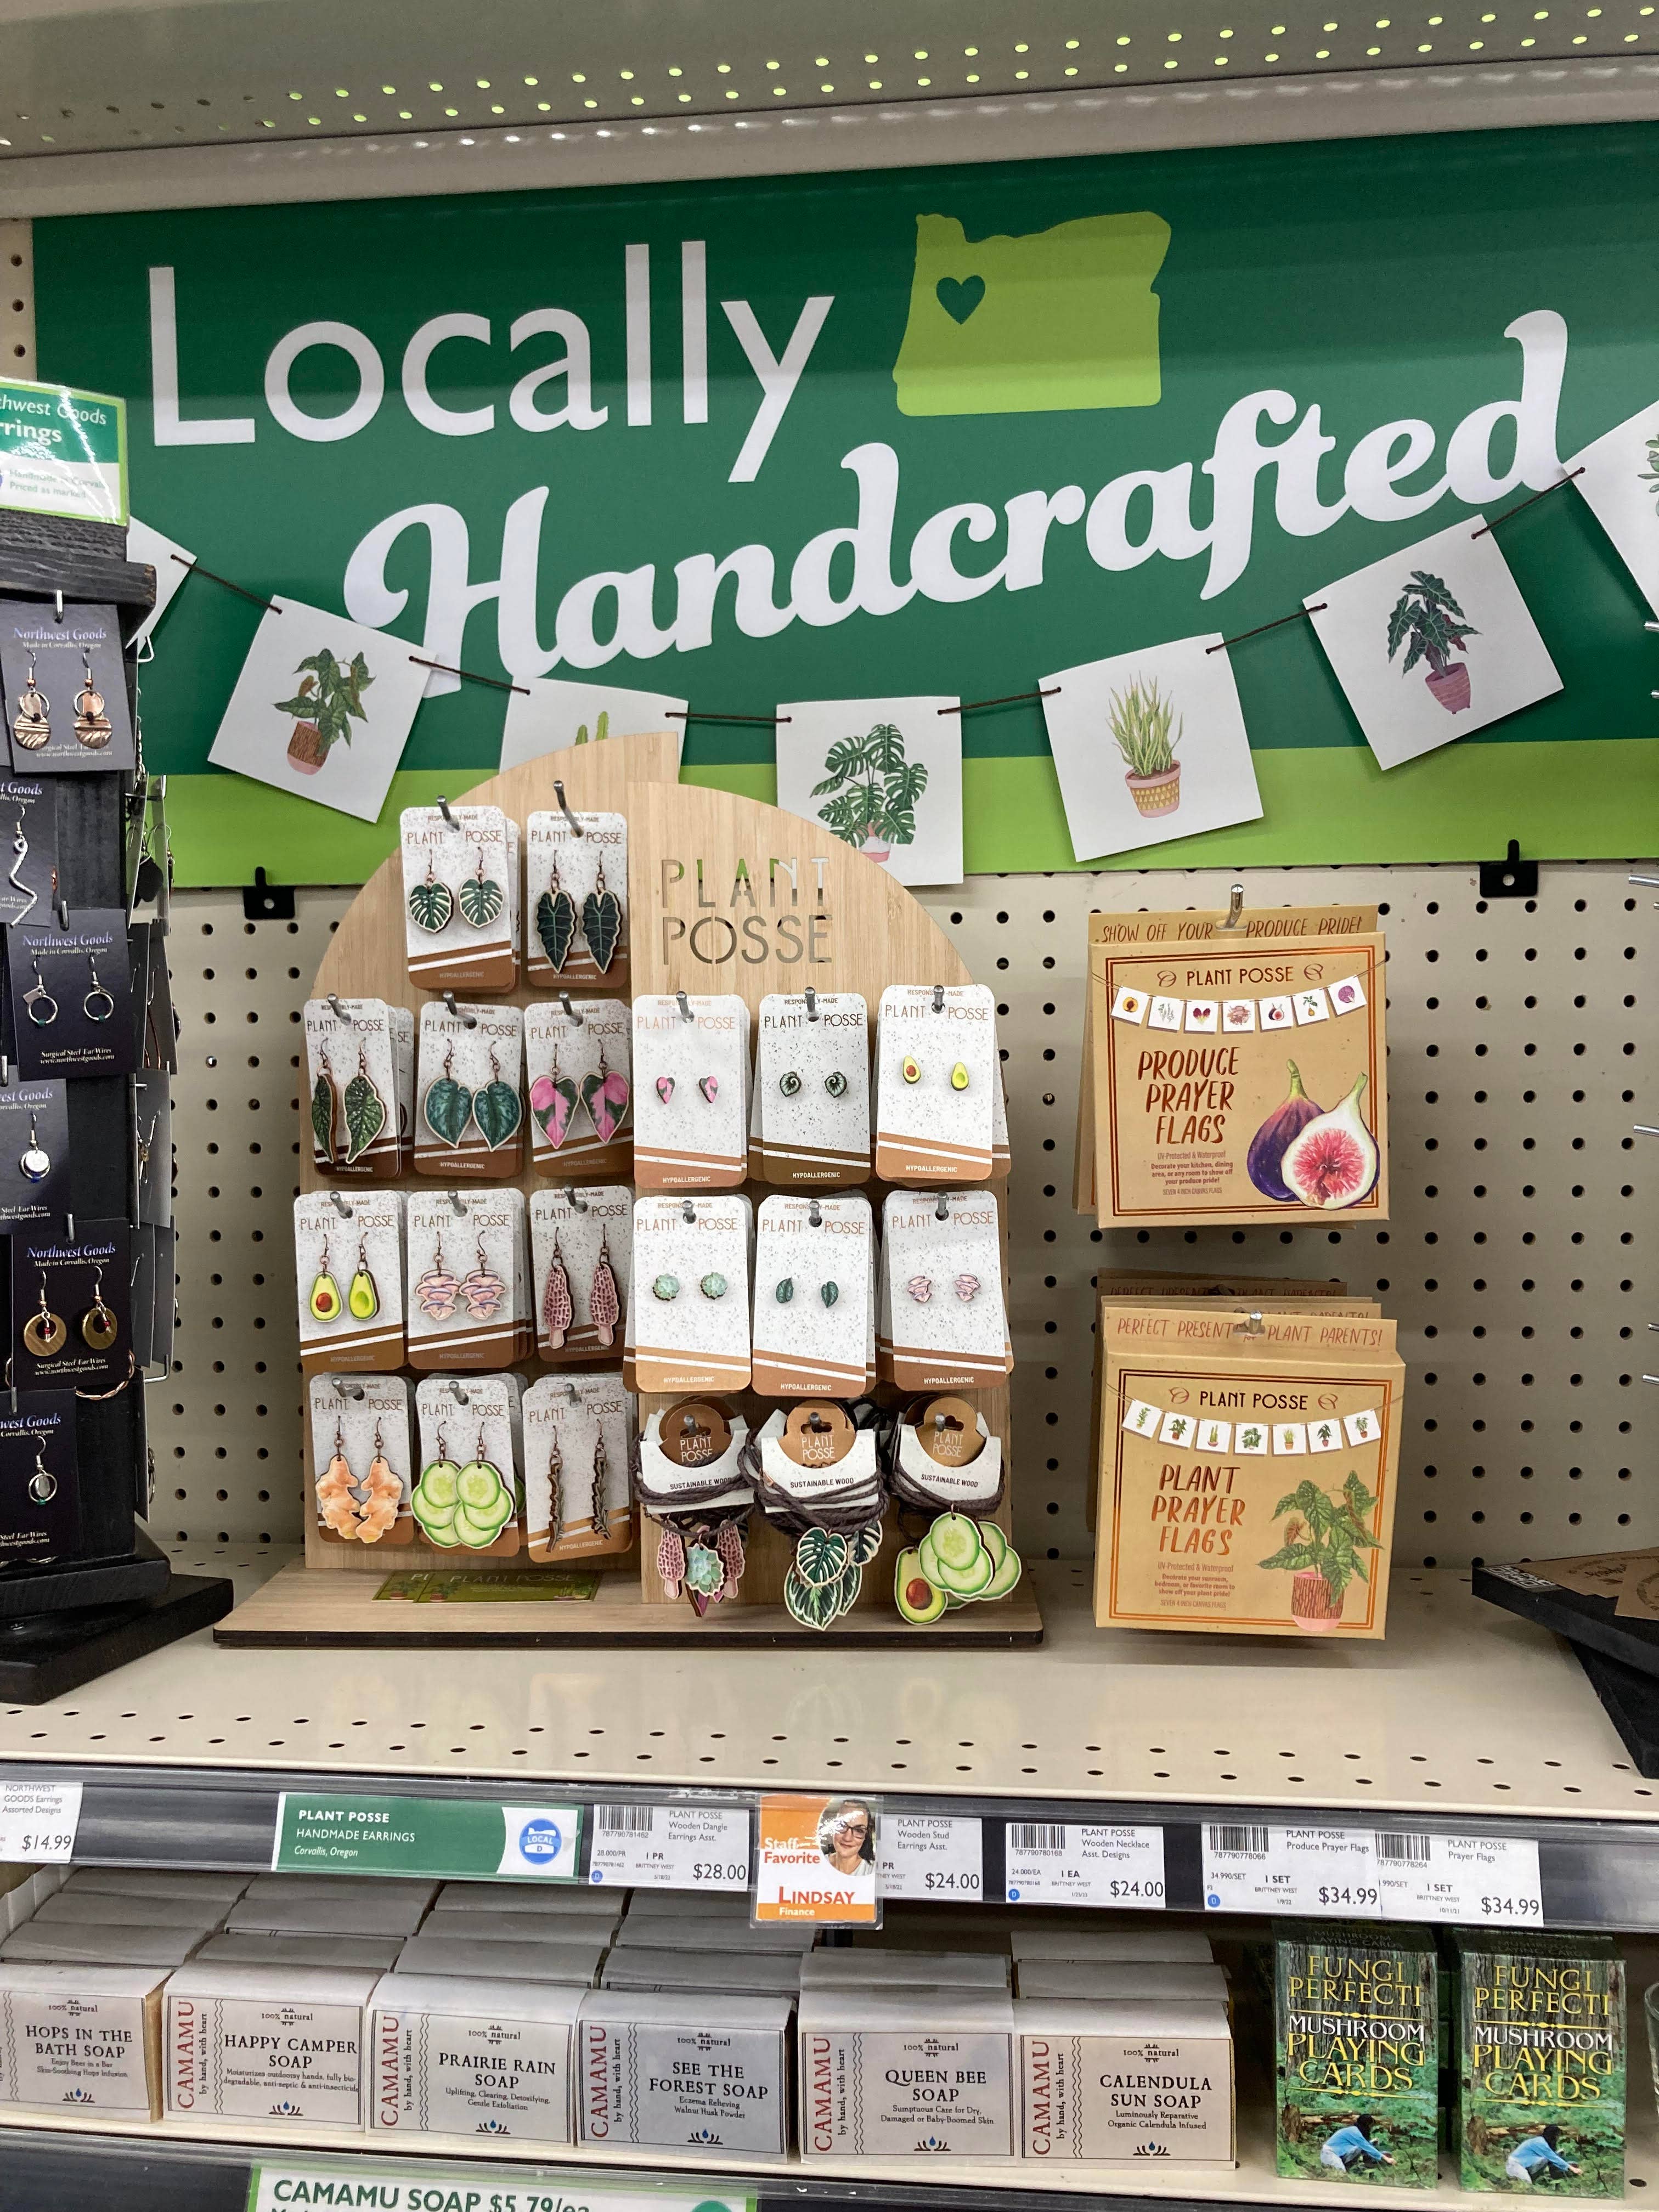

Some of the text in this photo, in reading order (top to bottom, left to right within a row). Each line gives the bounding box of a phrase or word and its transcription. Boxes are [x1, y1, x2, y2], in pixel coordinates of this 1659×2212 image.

[149, 240, 835, 483] Locally
[57, 404, 106, 425] Goods
[343, 310, 1569, 697] Handcrafted
[13, 627, 106, 640] Northwest Goods
[8, 781, 43, 795] Goods
[531, 831, 622, 844] PLANT POSSE
[662, 857, 829, 908] PLANT
[1102, 916, 1362, 943] SHOW OFF YOUR PRODUCE PRIDE!
[22, 931, 114, 947] Northwest Goods
[663, 915, 832, 965] POSSE
[1187, 966, 1294, 986] PLANT POSSE
[885, 1005, 989, 1020] PLANT POSSE
[637, 1017, 735, 1029] PLANT POSSE
[1138, 1047, 1240, 1080] PRODUCE
[1146, 1080, 1234, 1113] PRAYER
[1156, 1114, 1225, 1144] FLAGS
[1197, 1150, 1226, 1159] Waterproof
[637, 1218, 738, 1231] PLANT POSSE
[893, 1211, 994, 1228] PLANT POSSE
[27, 1242, 116, 1259] Northwest Goods
[1118, 1318, 1383, 1346] PERFECT PRESENT PLANT PARENTS!
[37, 1360, 61, 1370] Surgical
[1199, 1391, 1308, 1411] PLANT POSSE
[802, 1435, 833, 1448] PLANT
[803, 1447, 835, 1461] POSSE
[790, 1478, 834, 1488] SUSTAINABLE
[1159, 1464, 1241, 1494] PLANT
[1152, 1495, 1245, 1526] PRAYER
[1159, 1526, 1232, 1556] FLAGS
[36, 1795, 63, 1804] Earrings
[35, 1805, 61, 1815] Designs
[298, 1809, 390, 1823] PLANT POSSE
[22, 1835, 71, 1852] $14.99
[296, 1828, 415, 1842] HANDMADE EARRINGS
[527, 1834, 553, 1845] LOCAL
[898, 1830, 949, 1839] Wooden Stud
[1082, 1839, 1149, 1848] Wooden Necklace
[294, 1846, 358, 1858] Corvallis, Oregon
[898, 1842, 947, 1852] Earrings Asst.
[1102, 1850, 1130, 1860] Designs
[1287, 1841, 1369, 1854] Produce Prayer Flags
[764, 1851, 820, 1864] Favorite
[693, 1863, 746, 1881] $28.00
[925, 1872, 979, 1891] $24.00
[1110, 1880, 1164, 1898] $24.00
[778, 1886, 855, 1904] LINDSAY
[1319, 1886, 1378, 1906] $34.99
[779, 1906, 815, 1916] Finance
[1481, 1896, 1539, 1916] $34.99
[1308, 1955, 1404, 1983] FUNGI
[1494, 1965, 1593, 1992] FUNGI
[1289, 1976, 1422, 2007] PERFECTI
[1475, 1987, 1611, 2016] PERFECTI
[25, 2025, 132, 2042] HOPS IN THE
[1289, 2015, 1425, 2042] MUSHROOM
[224, 2034, 357, 2054] HAPPY CAMPER
[1474, 2026, 1613, 2051] MUSHROOM
[35, 2042, 125, 2058] BATH SOAP
[177, 2001, 194, 2109] CAMAMU
[1148, 2049, 1178, 2057] natural
[1288, 2033, 1425, 2067] PLAYING
[269, 2055, 312, 2068] SOAP
[439, 2052, 555, 2075] PRAIRIE RAIN
[1473, 2044, 1612, 2076] PLAYING
[381, 2016, 399, 2126] CAMAMU
[673, 2062, 744, 2079] SEE THE
[885, 2069, 987, 2087] QUEEN BEE
[1299, 2061, 1413, 2091] CARDS
[475, 2074, 518, 2089] SOAP
[589, 2026, 609, 2138] CAMAMU
[649, 2078, 768, 2100] FOREST SOAP
[1099, 2074, 1212, 2091] CALENDULA
[1485, 2072, 1601, 2101] CARDS
[813, 2037, 833, 2151] CAMAMU
[912, 2089, 960, 2102] SOAP
[1032, 2040, 1051, 2155] CAMAMU
[1110, 2094, 1201, 2108] SUN SOAP
[274, 2180, 482, 2212] CAMAMU SOAP
